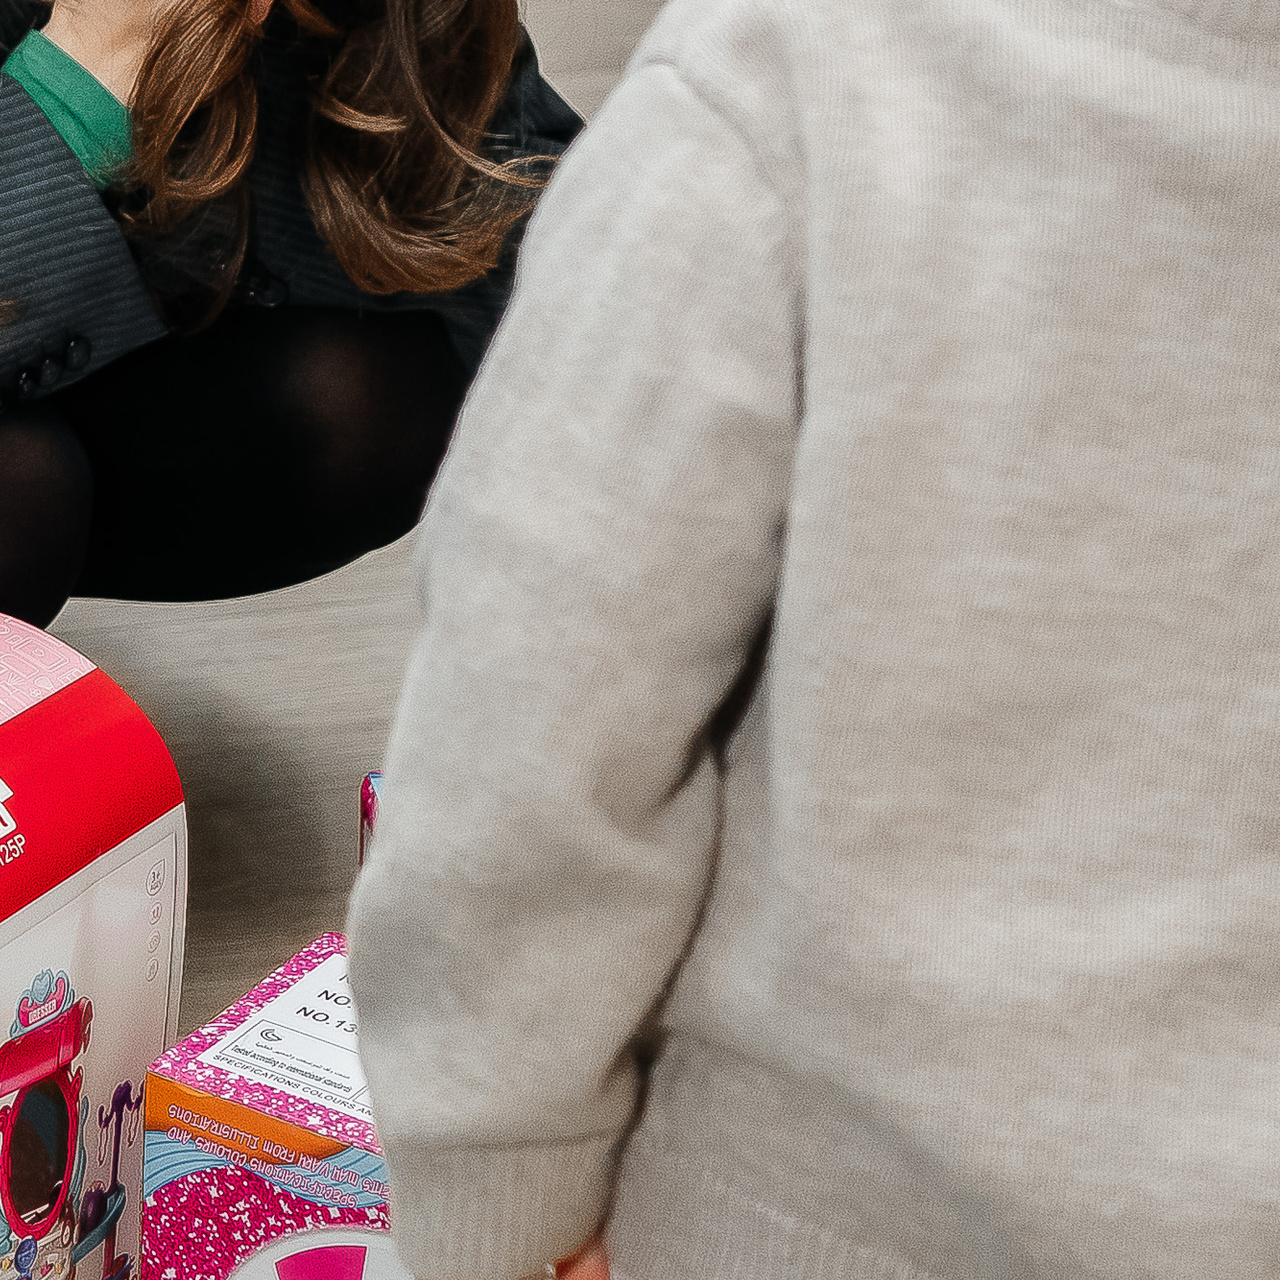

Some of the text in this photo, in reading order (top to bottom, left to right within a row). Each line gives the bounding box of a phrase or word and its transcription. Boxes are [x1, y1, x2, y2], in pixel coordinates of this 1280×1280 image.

[295, 1006, 359, 1037] NO.13
[213, 1054, 301, 1090] SPECIFICATIONS
[302, 1086, 356, 1110] COLOURS
[195, 1136, 248, 1166] COLOURS
